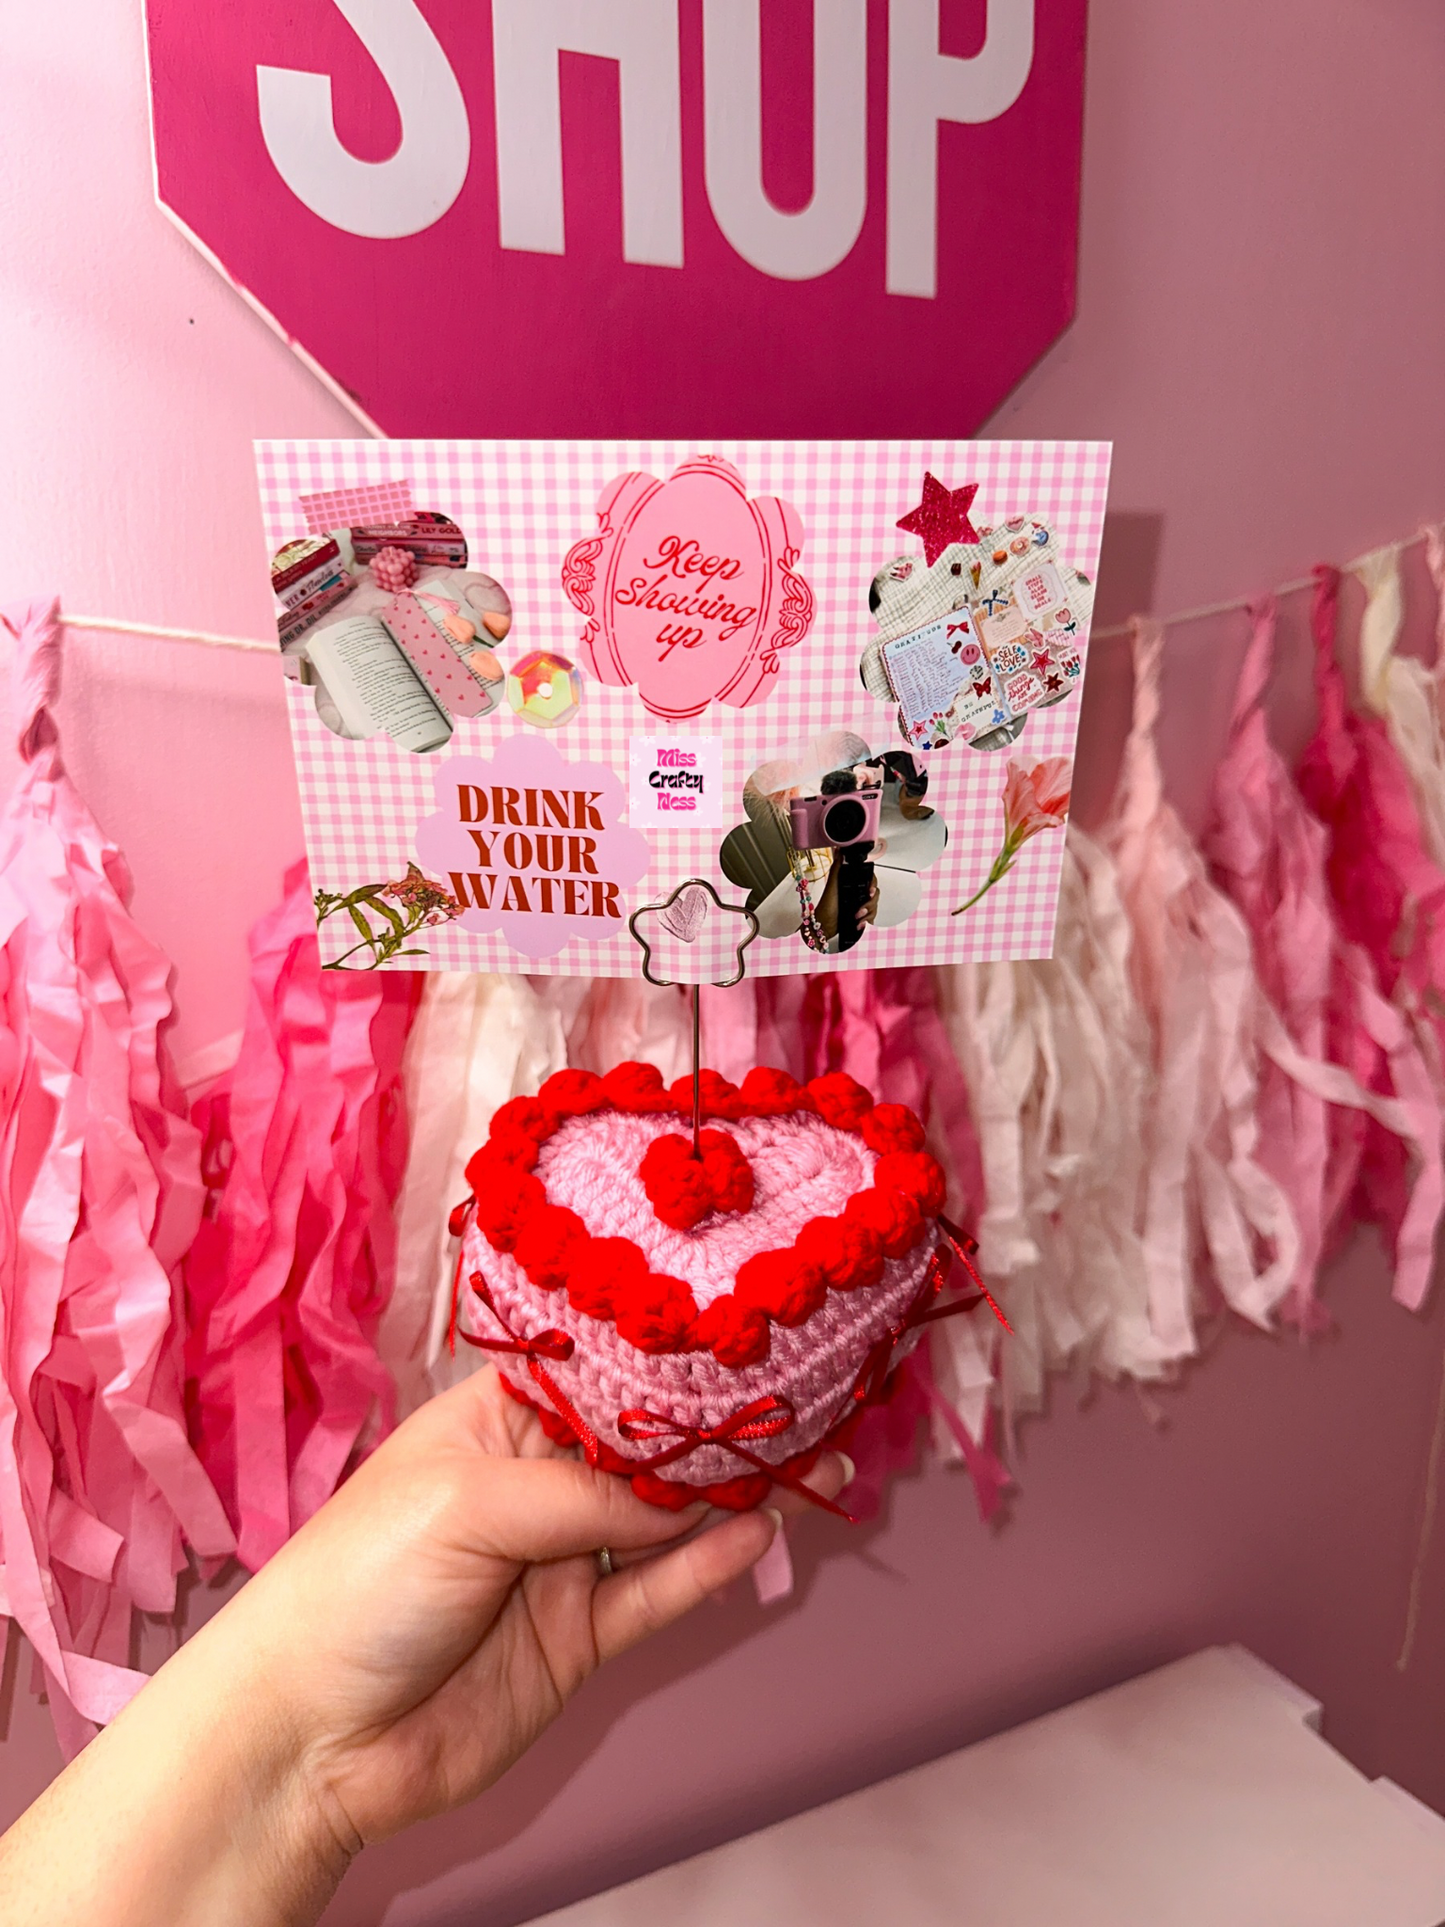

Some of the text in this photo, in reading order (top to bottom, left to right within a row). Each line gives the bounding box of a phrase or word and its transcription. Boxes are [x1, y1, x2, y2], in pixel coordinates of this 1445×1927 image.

[643, 535, 744, 594] Keep
[656, 624, 707, 662] up
[1000, 654, 1021, 672] LOVE
[456, 784, 605, 831] DRINK
[467, 829, 599, 875] YOUR
[447, 871, 622, 919] WATER
